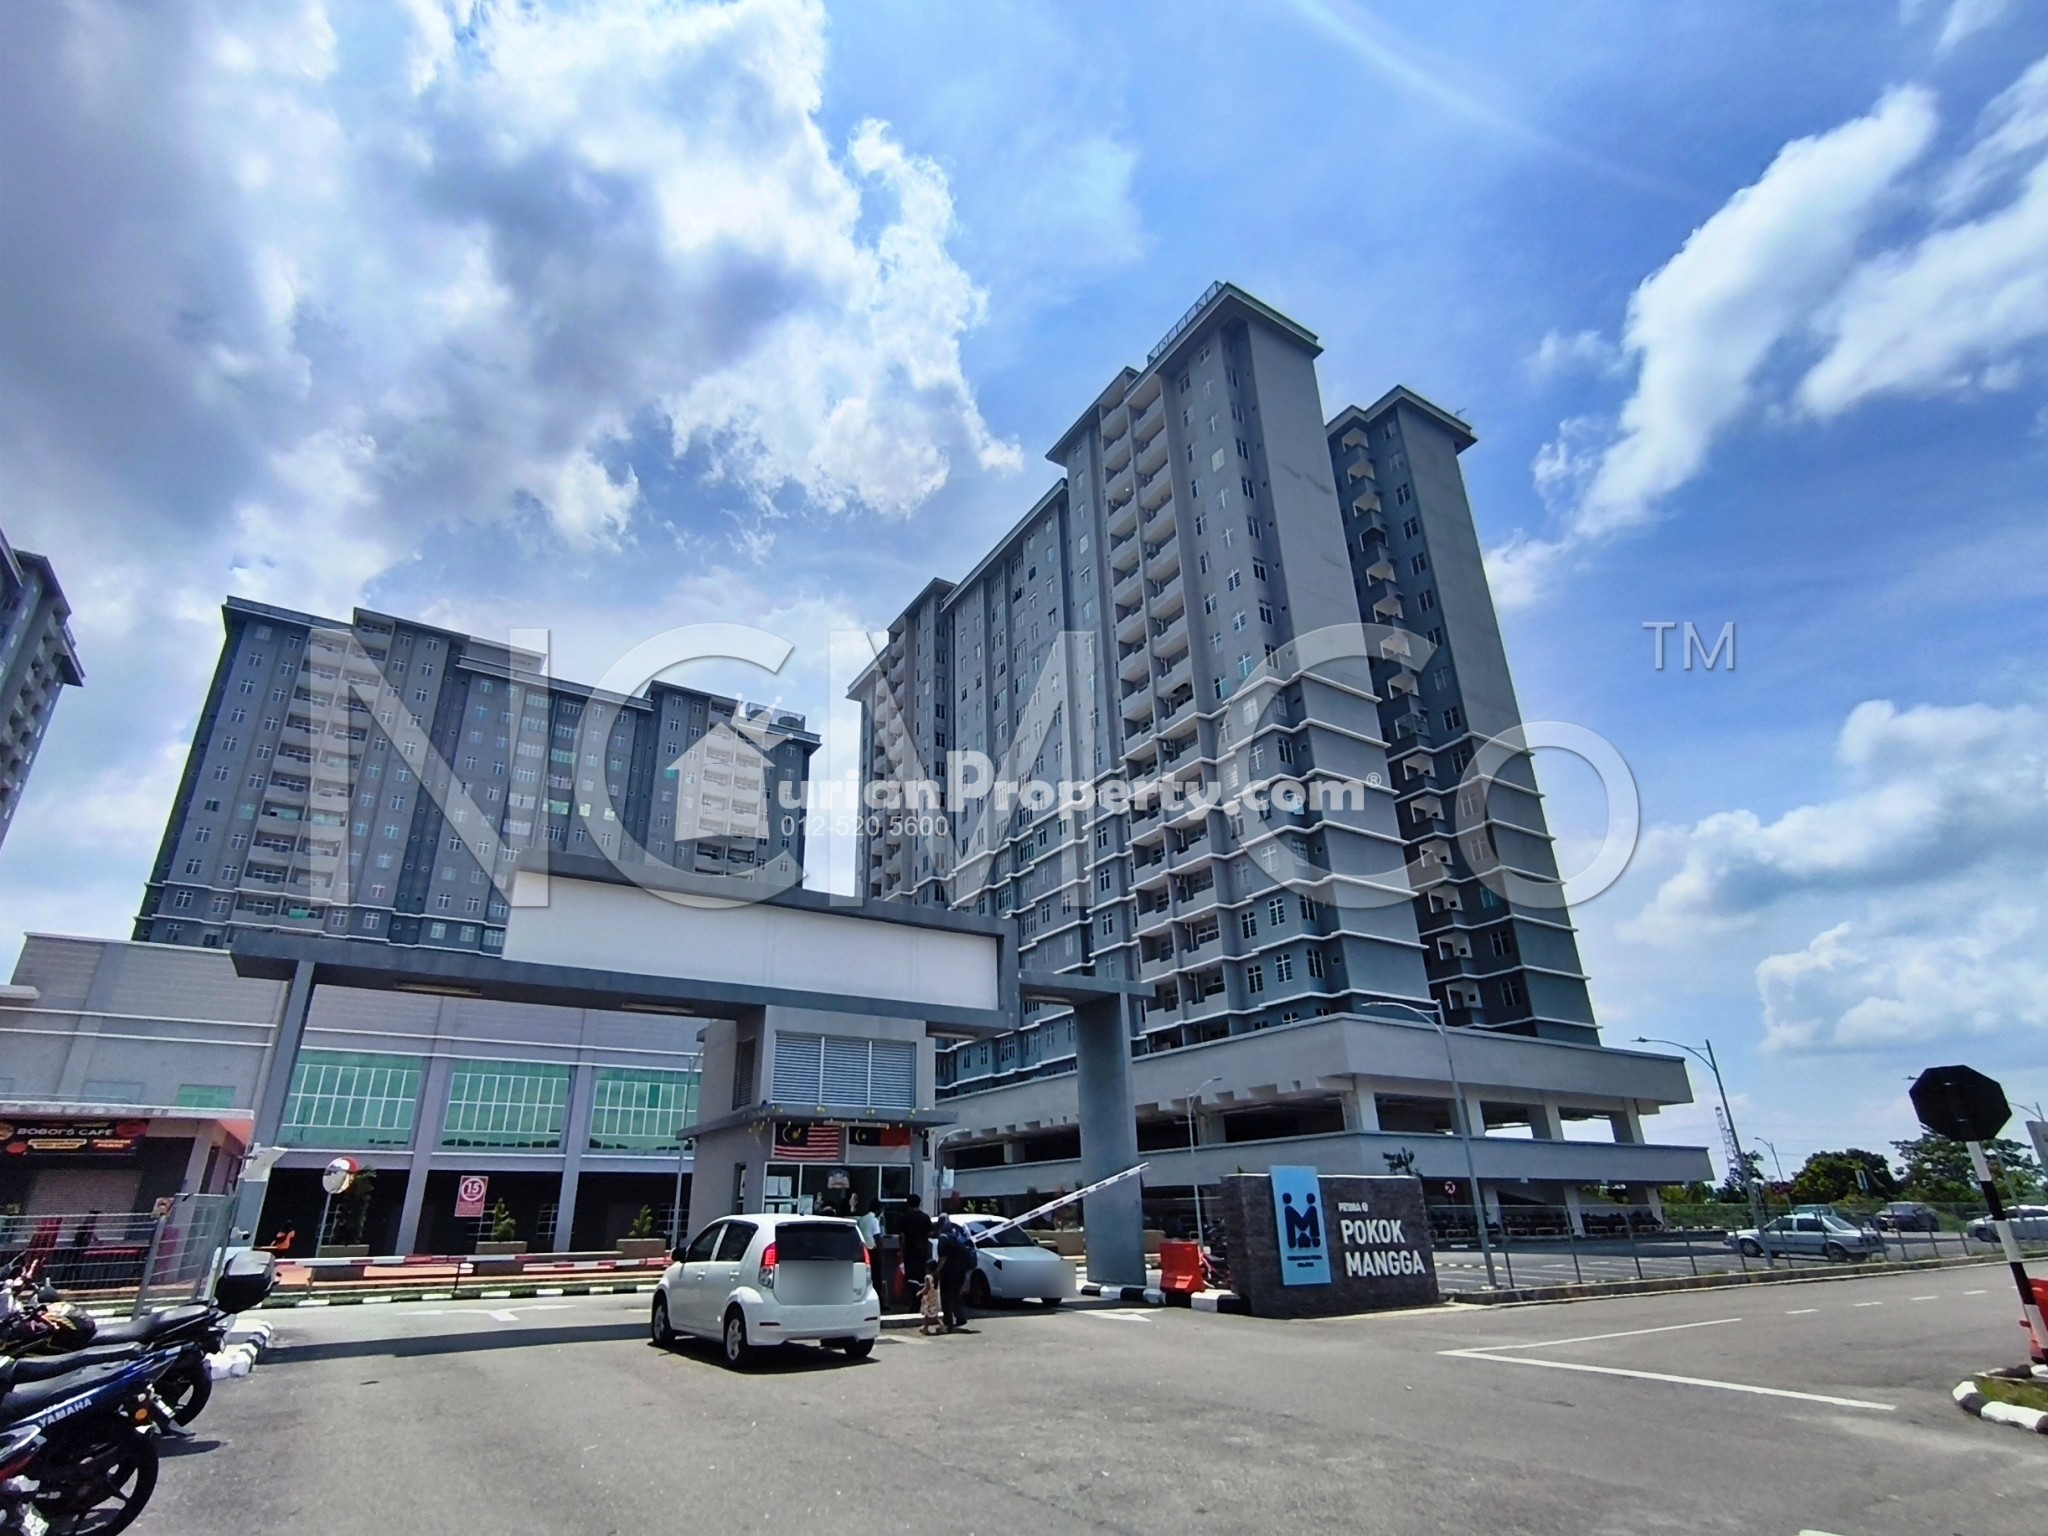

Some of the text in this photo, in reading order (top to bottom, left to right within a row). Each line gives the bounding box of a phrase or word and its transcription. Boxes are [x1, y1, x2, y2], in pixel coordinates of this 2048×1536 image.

[466, 1182, 481, 1194] 15
[1340, 1219, 1406, 1245] POKOK
[1344, 1249, 1427, 1277] MANGGA
[38, 1397, 93, 1428] YAMAHA
